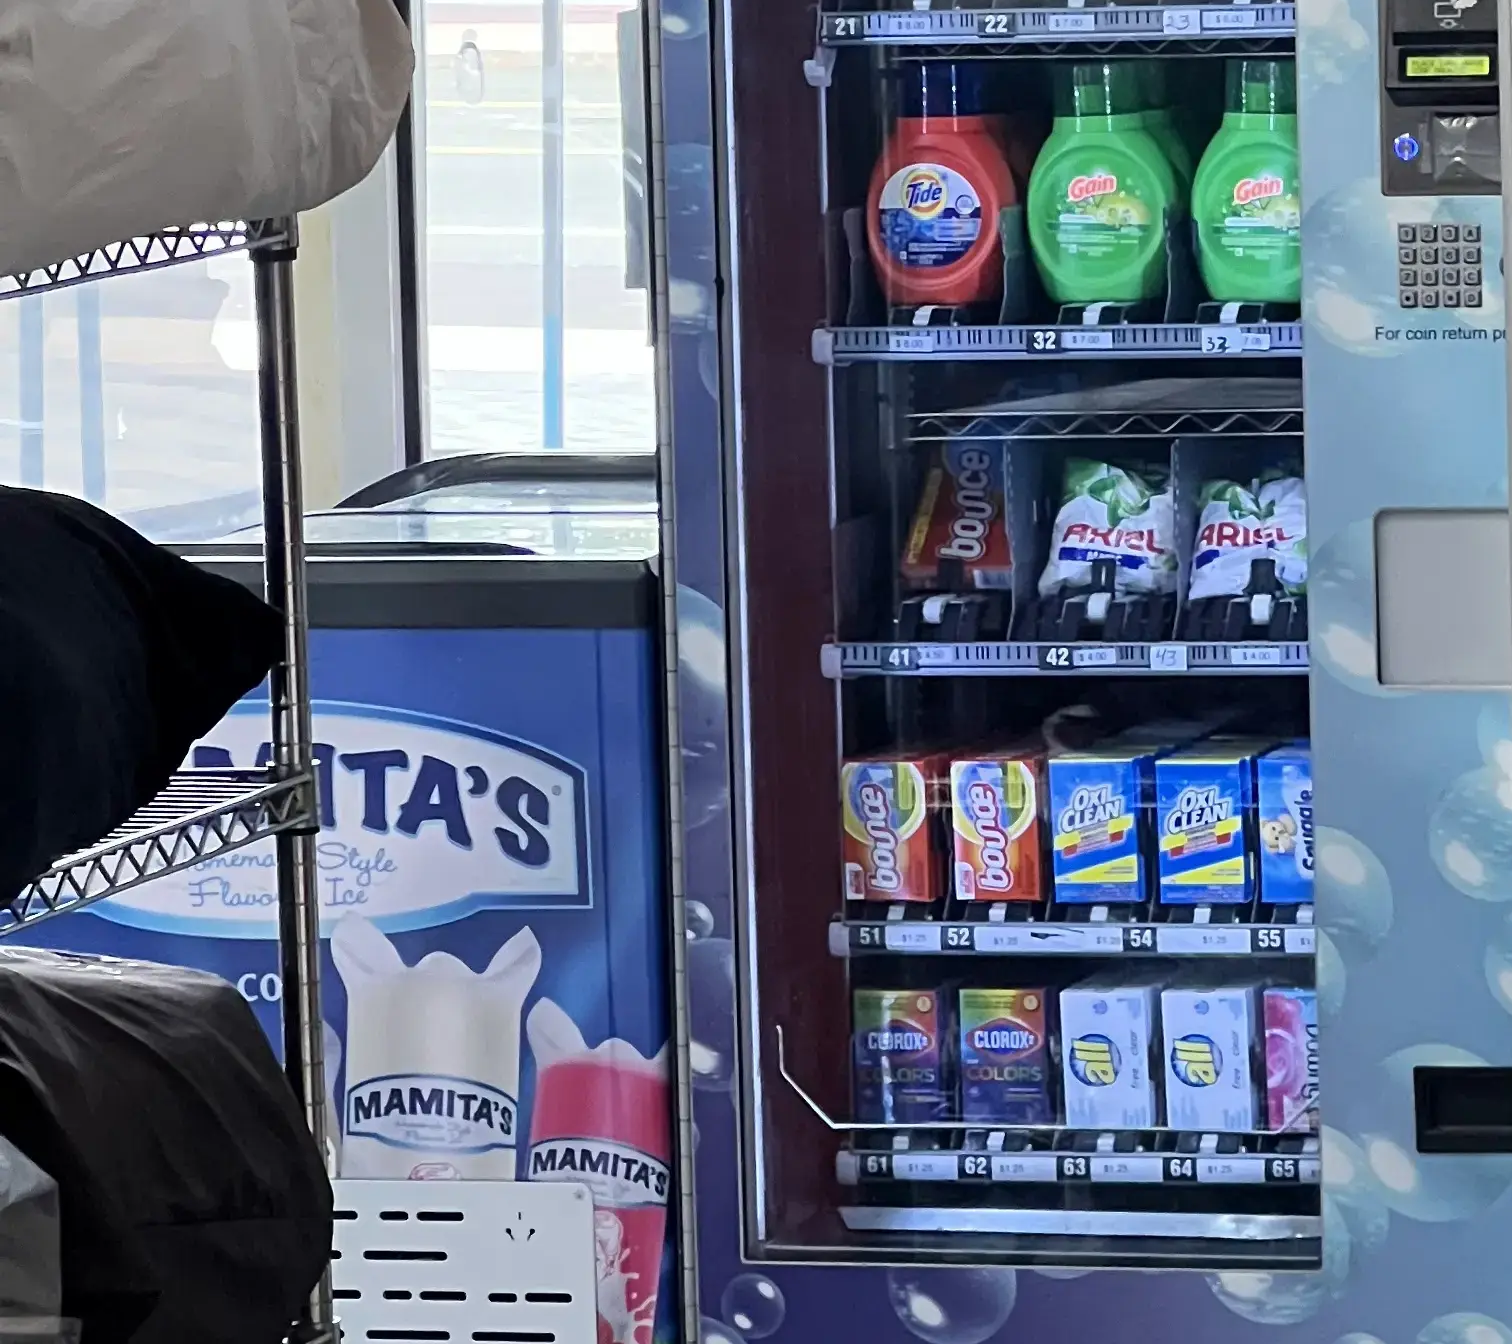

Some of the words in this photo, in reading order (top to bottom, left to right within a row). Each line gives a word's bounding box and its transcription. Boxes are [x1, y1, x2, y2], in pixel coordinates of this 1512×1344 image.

[835, 17, 856, 35] 21
[985, 14, 1008, 33] 22
[907, 182, 942, 208] Tide
[1070, 176, 1115, 199] Gain
[1236, 177, 1282, 203] Gain
[1033, 332, 1056, 350] 32
[1375, 326, 1401, 340] For
[1406, 328, 1436, 340] coin
[1442, 327, 1487, 340] return
[940, 449, 991, 560] bounce
[889, 648, 909, 666] 41
[1046, 647, 1069, 666] 42
[1156, 648, 1177, 667] 43
[1072, 786, 1108, 810] OXI
[1179, 788, 1217, 811] OXI
[1061, 798, 1121, 833] CLEAN
[1167, 800, 1229, 835] CLEAN
[970, 783, 1011, 889] bounce
[318, 842, 397, 887] Style
[325, 877, 369, 907] Ice
[860, 928, 880, 945] 51
[947, 928, 970, 946] 52
[1129, 929, 1152, 947] 54
[1258, 930, 1281, 948] 55
[966, 1065, 1042, 1081] COLORS
[353, 1087, 513, 1137] MAMITA'S
[532, 1147, 668, 1199] MAMITA'S
[867, 1155, 887, 1173] 61
[964, 1157, 987, 1175] 62
[1063, 1158, 1086, 1177] 63
[1170, 1159, 1193, 1177] 64
[1272, 1159, 1294, 1177] 65
